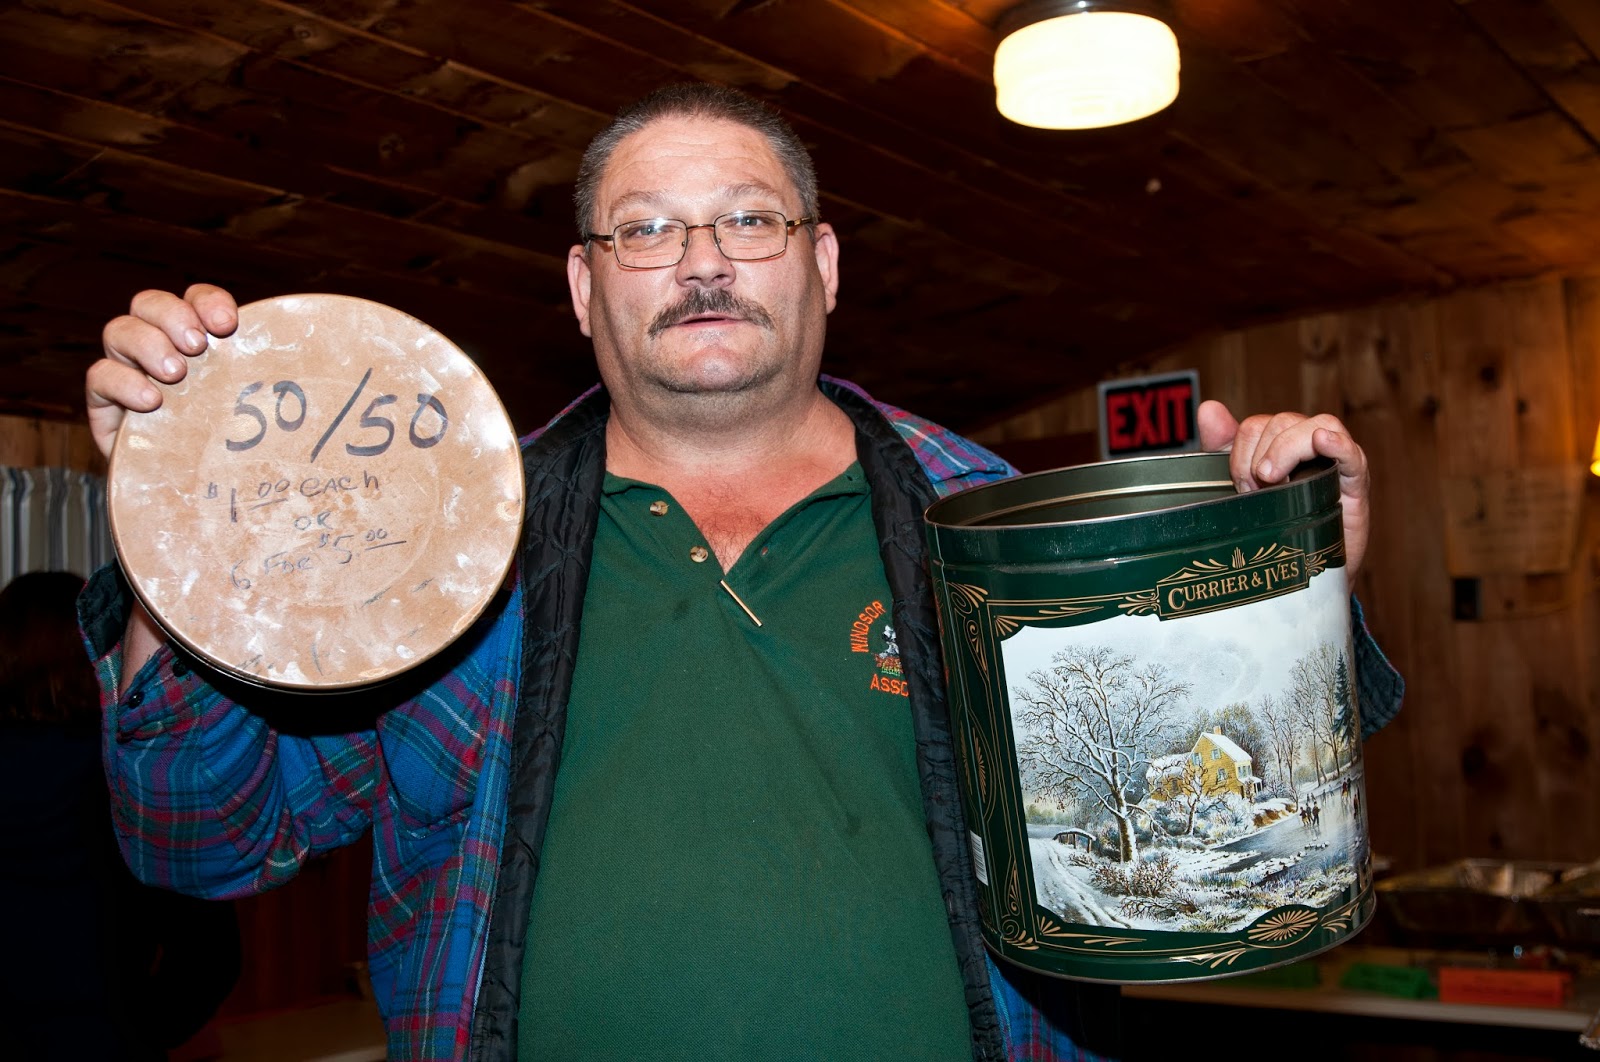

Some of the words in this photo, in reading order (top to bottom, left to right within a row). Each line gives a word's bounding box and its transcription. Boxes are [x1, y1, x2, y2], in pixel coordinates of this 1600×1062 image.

[225, 367, 449, 463] 50/50
[1107, 384, 1192, 450] EXIT
[294, 511, 333, 530] OR
[230, 559, 252, 590] 6
[1167, 573, 1250, 611] CURRIER
[1251, 571, 1264, 588] &
[1264, 561, 1300, 591] IVES
[850, 600, 887, 653] WINDSOR
